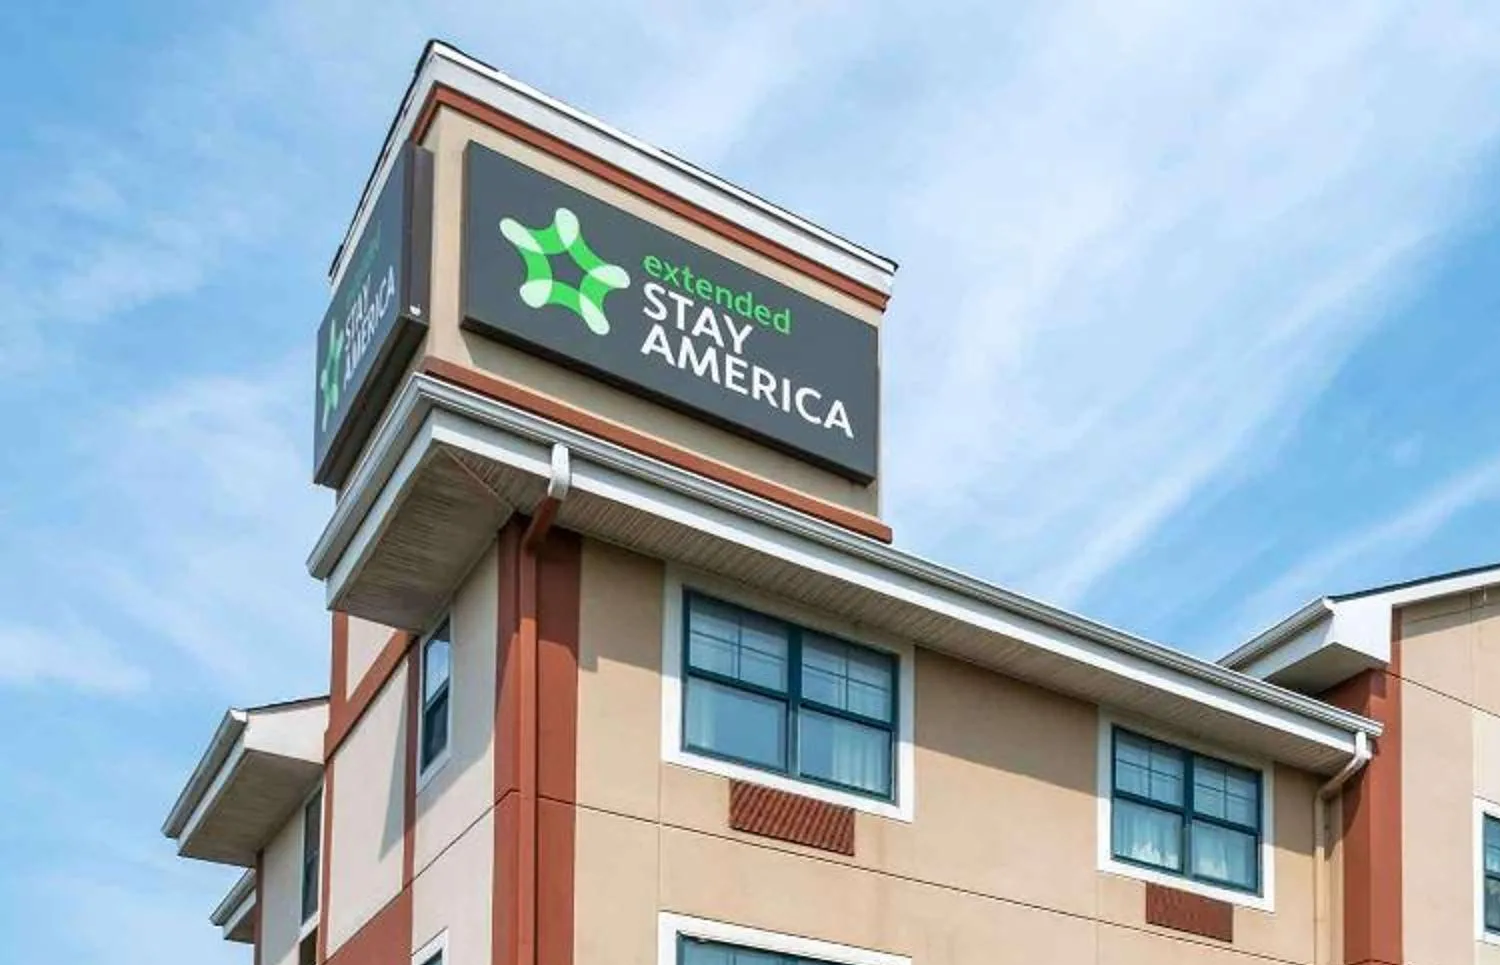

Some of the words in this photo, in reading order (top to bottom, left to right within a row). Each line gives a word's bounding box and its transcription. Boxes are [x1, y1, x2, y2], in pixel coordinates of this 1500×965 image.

[343, 265, 396, 390] AMERICA
[345, 273, 371, 350] STAY
[643, 255, 791, 333] extended
[643, 282, 753, 354] STAY
[641, 324, 854, 439] AMERICA
